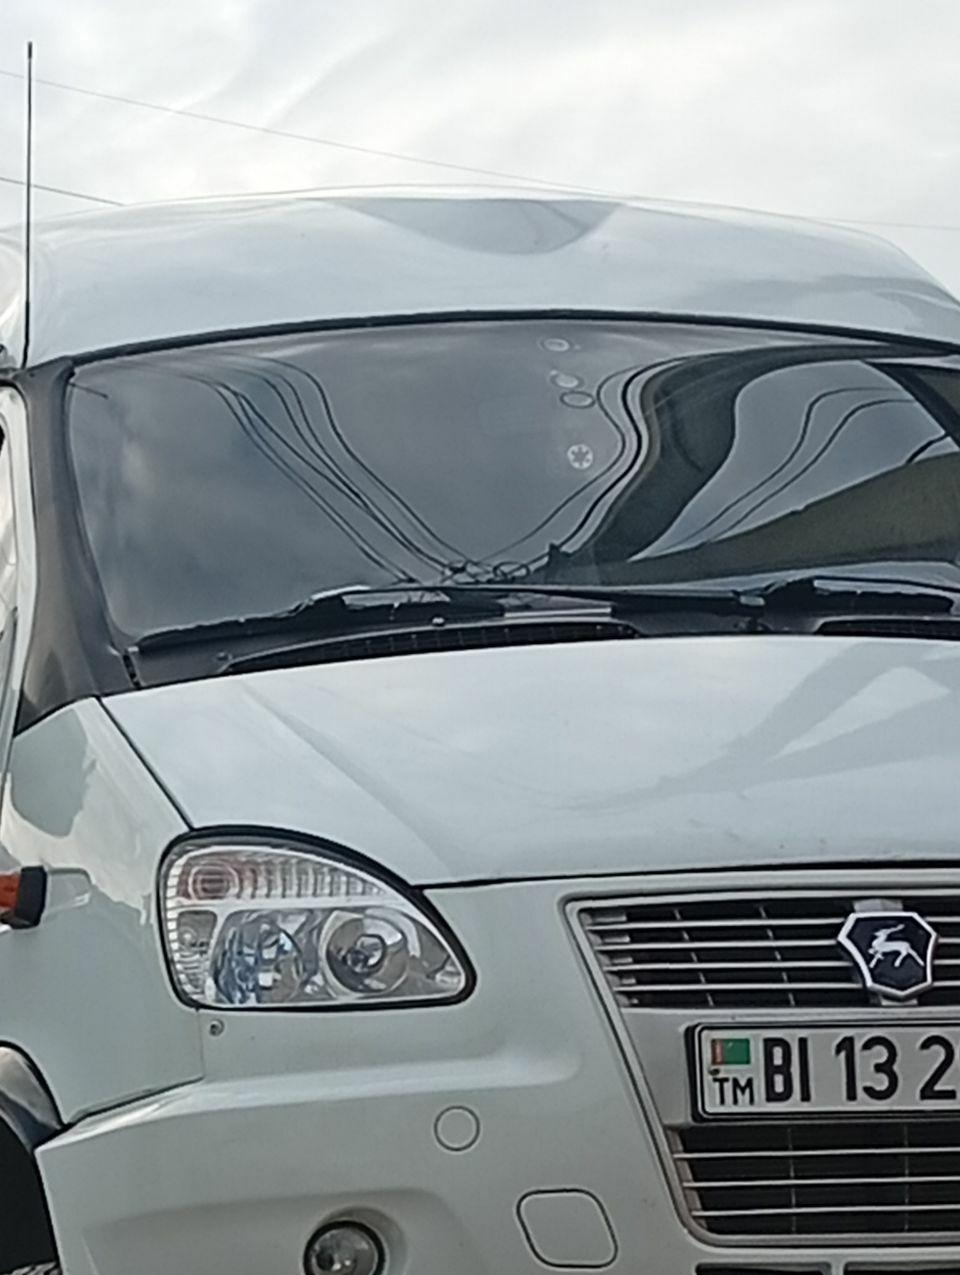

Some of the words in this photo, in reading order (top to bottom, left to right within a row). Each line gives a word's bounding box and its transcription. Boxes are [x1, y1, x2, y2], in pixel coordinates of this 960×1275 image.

[712, 1076, 755, 1106] TM
[762, 1036, 811, 1102] BI
[835, 1035, 899, 1101] 13
